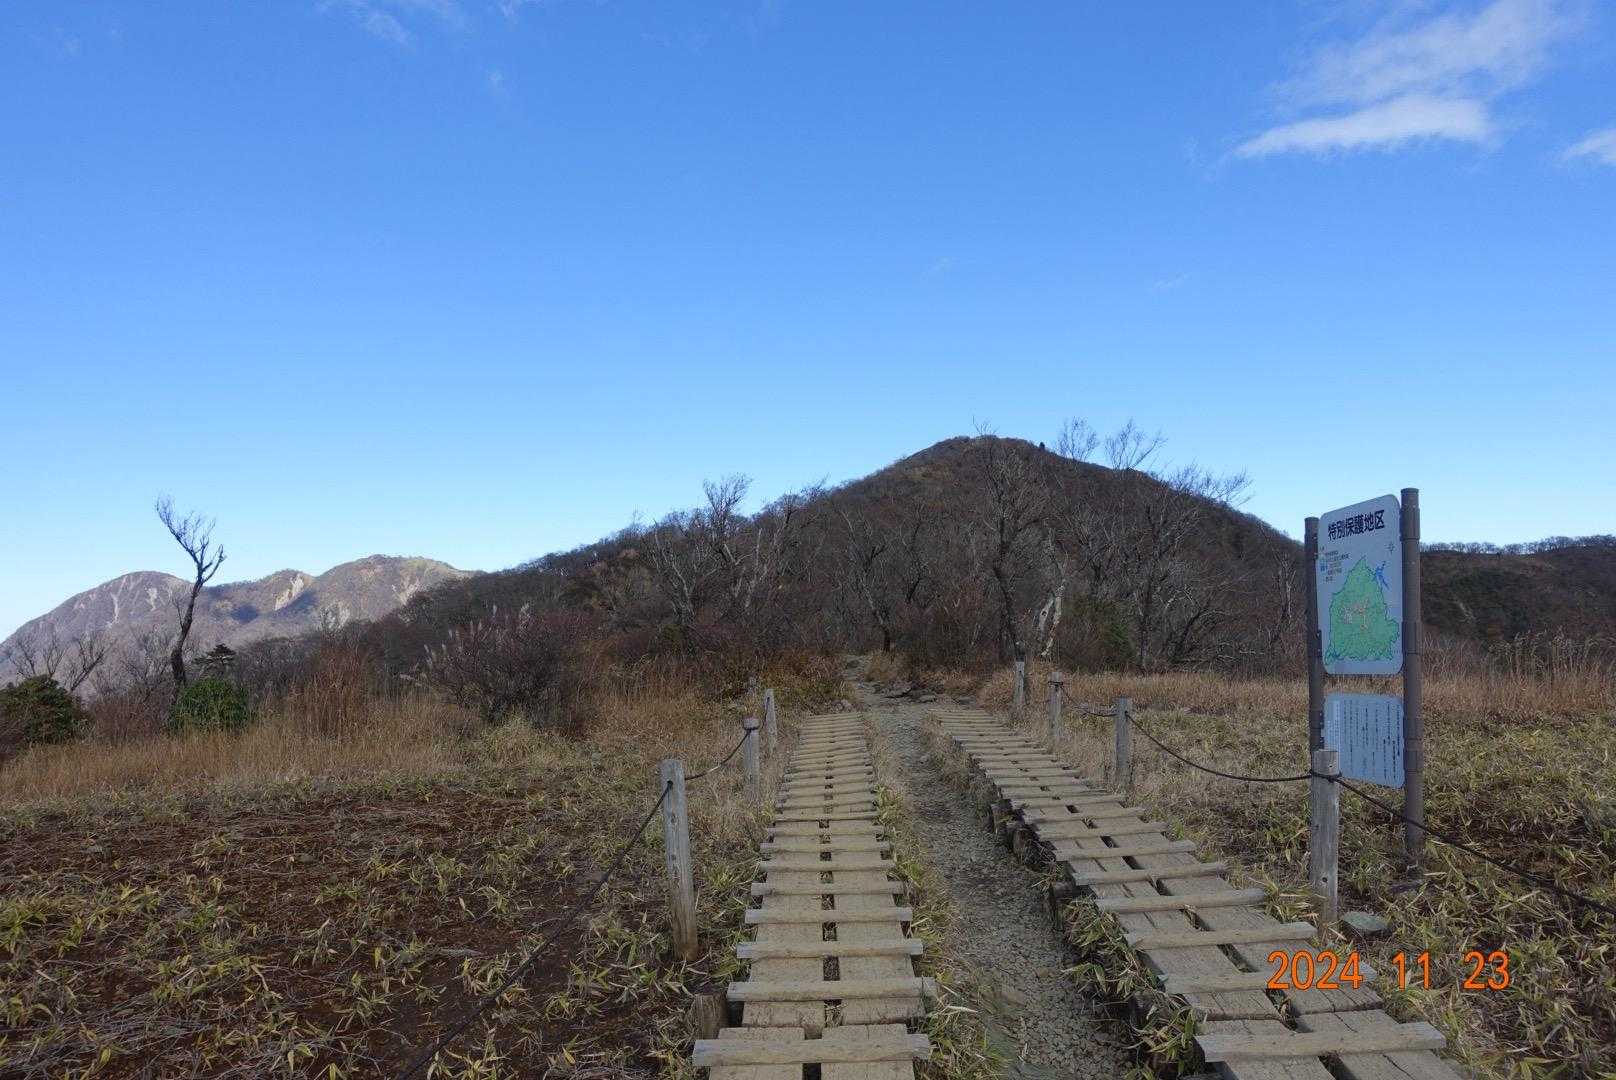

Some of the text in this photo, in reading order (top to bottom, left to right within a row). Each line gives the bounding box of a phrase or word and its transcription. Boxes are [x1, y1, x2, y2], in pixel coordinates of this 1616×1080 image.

[1328, 509, 1385, 541] 特別保護地区
